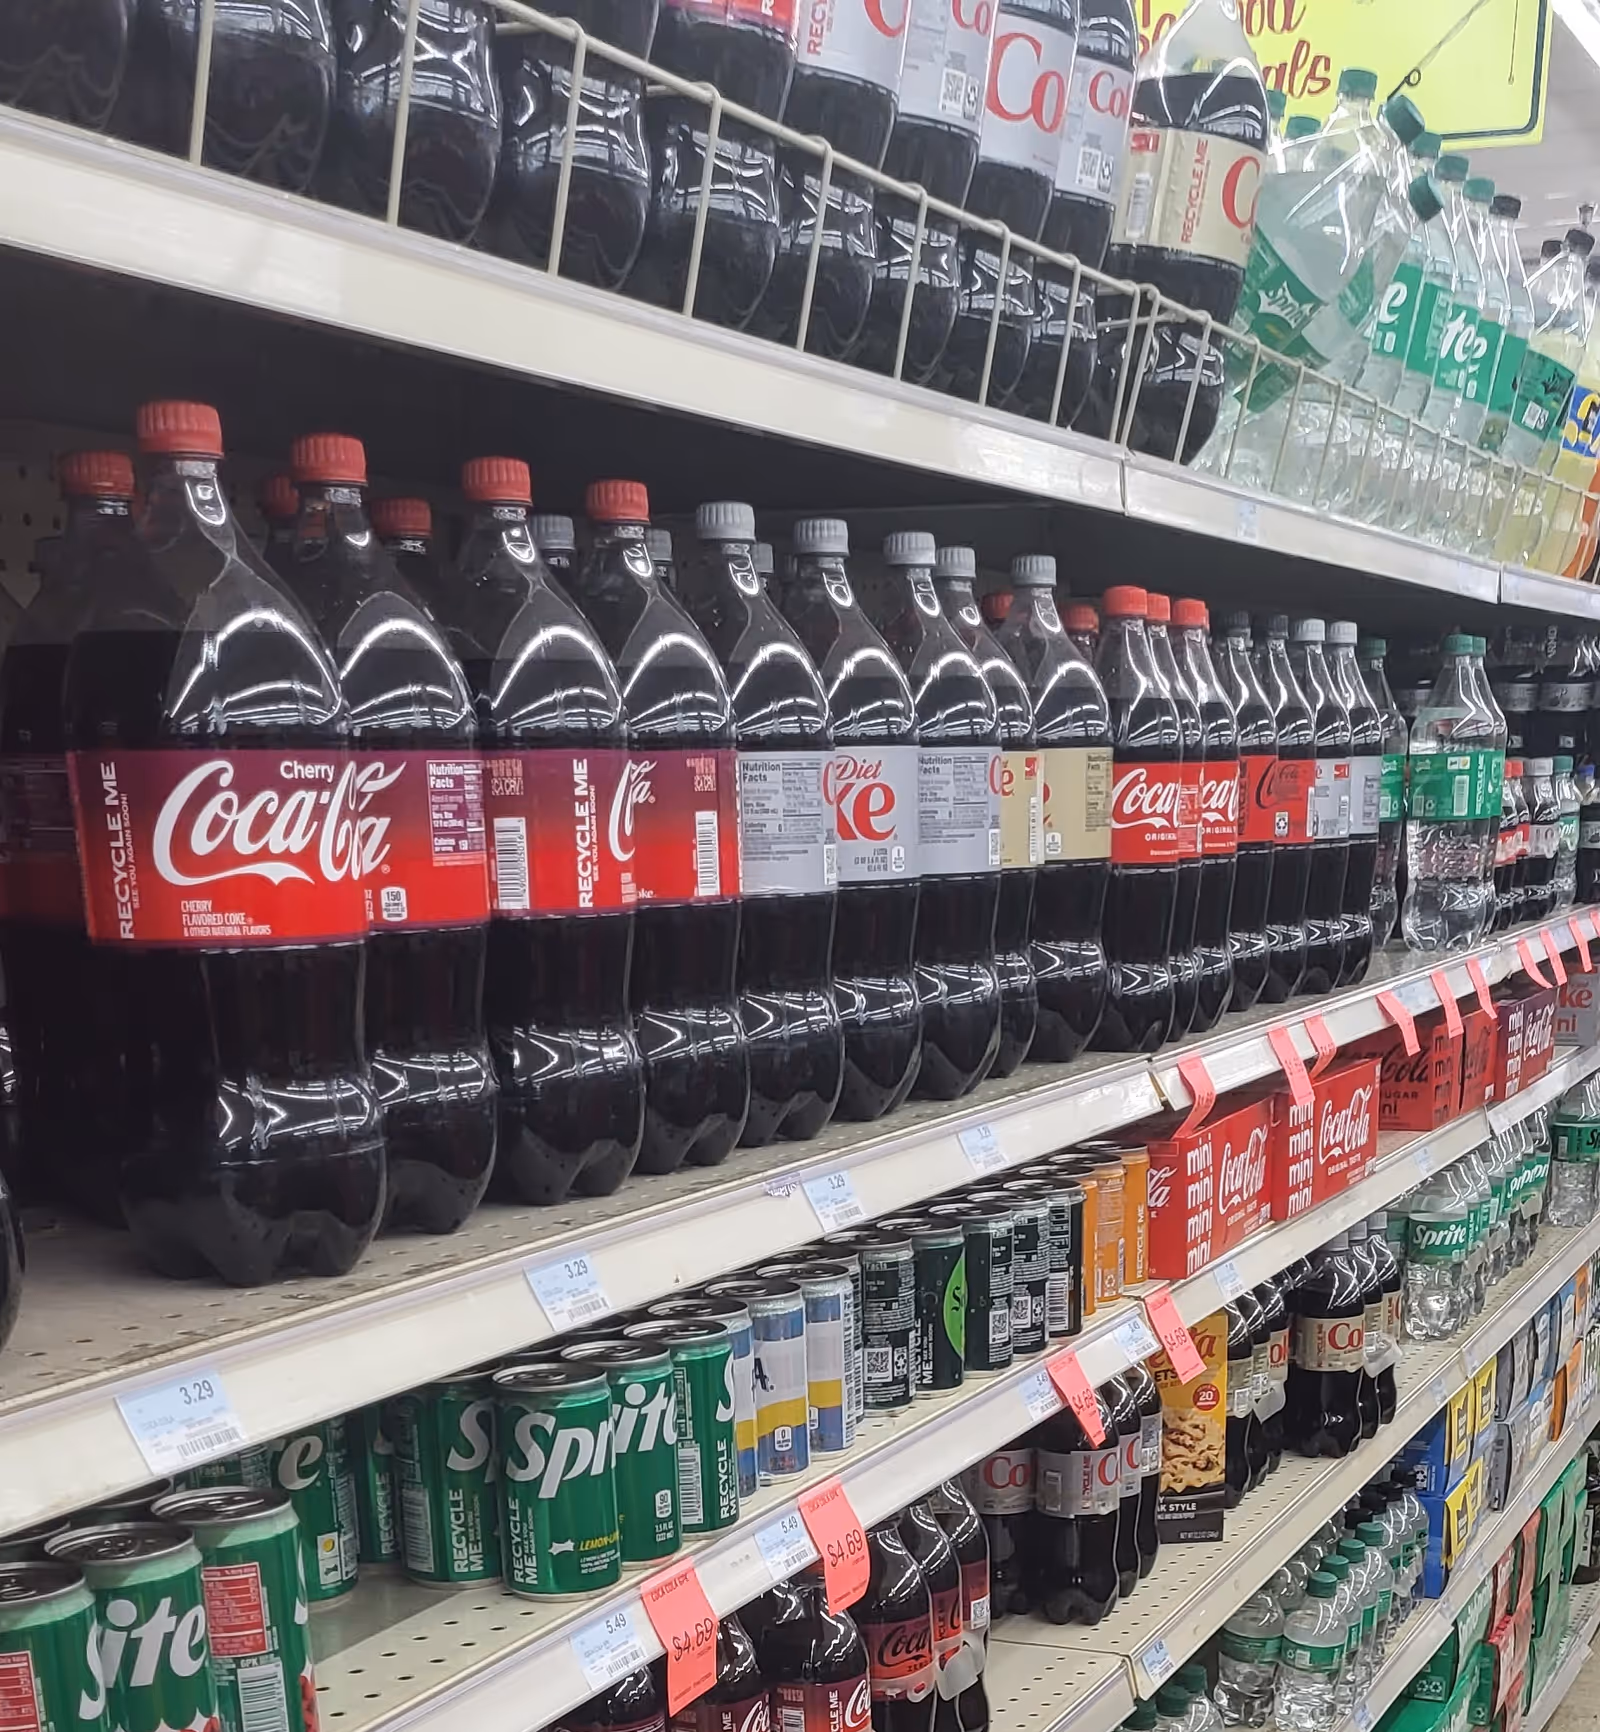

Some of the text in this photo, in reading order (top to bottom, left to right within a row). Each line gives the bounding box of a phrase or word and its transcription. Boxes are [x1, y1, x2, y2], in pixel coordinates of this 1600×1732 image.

[1181, 138, 1210, 244] RECYCLE ME
[279, 760, 335, 781] Cherry
[428, 763, 464, 776] Nutrition
[742, 762, 781, 772] Nutrition
[742, 773, 768, 783] Facts
[836, 755, 883, 781] Diet
[429, 776, 455, 789] Facts
[120, 793, 131, 828] SOON!
[124, 830, 136, 863] AGAIN
[572, 758, 594, 908] RECYCLE ME
[100, 761, 135, 940] RECYCLE ME
[180, 900, 212, 913] CHERRY
[385, 891, 401, 901] 150
[182, 913, 246, 926] FLAVORED COKE
[1318, 1084, 1373, 1166] Coca-Cola
[1288, 1120, 1314, 1158] mini
[1187, 1132, 1213, 1177] mini
[1288, 1148, 1314, 1188] mini
[1218, 1125, 1268, 1215] Coca-Cola
[1187, 1164, 1214, 1210] mini
[1287, 1178, 1313, 1220] mini
[1187, 1197, 1213, 1243] mini
[1136, 1204, 1145, 1279] RECYCLE ME
[1412, 1223, 1467, 1250] Sprite
[1186, 1229, 1212, 1276] mini
[566, 1259, 589, 1280] 3.29
[922, 1360, 934, 1384] ME
[179, 1379, 215, 1406] 3.29
[1199, 1391, 1213, 1401] 20
[717, 1438, 731, 1520] RECYCLE
[659, 1492, 669, 1505] 90
[728, 1491, 737, 1516] ME
[1168, 1501, 1197, 1512] STYLE
[449, 1488, 469, 1574] RECYCLE
[781, 1515, 799, 1534] 5.49
[508, 1496, 525, 1583] RECYCLE
[826, 1528, 864, 1569] $4.69
[468, 1541, 485, 1572] ME
[524, 1553, 539, 1585] ME
[650, 1588, 664, 1603] COCA
[605, 1612, 627, 1635] 5.49
[671, 1616, 714, 1662] $4.69
[239, 1656, 260, 1668] 6PK
[829, 1690, 839, 1708] ME
[721, 1711, 732, 1732] ME
